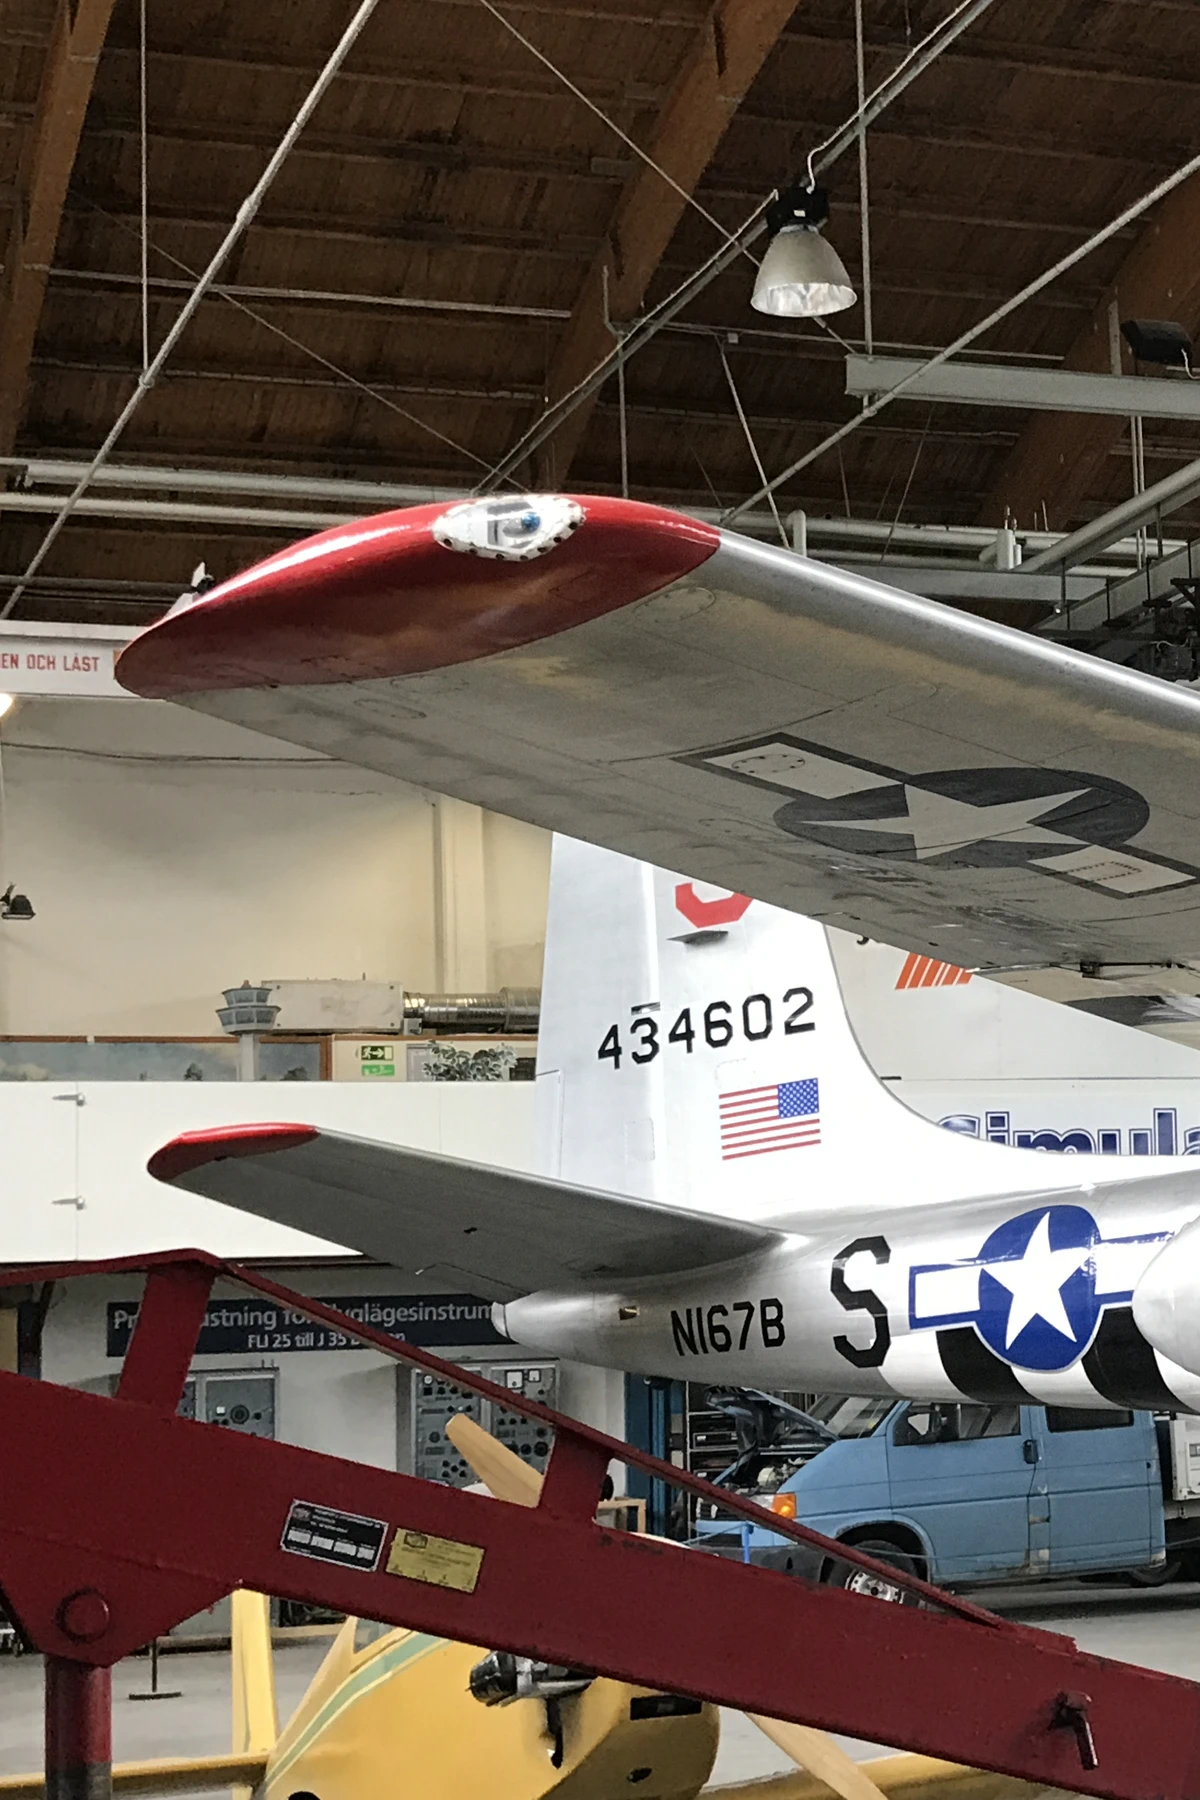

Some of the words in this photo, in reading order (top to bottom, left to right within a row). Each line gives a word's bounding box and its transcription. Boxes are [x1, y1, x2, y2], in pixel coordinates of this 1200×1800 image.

[27, 654, 56, 670] OCH
[597, 986, 816, 1070] 434602
[670, 1298, 785, 1356] N167B
[830, 1235, 891, 1368] S
[272, 1333, 292, 1348] 25
[294, 1332, 314, 1347] till
[316, 1332, 325, 1347] J
[328, 1331, 347, 1346] 35
